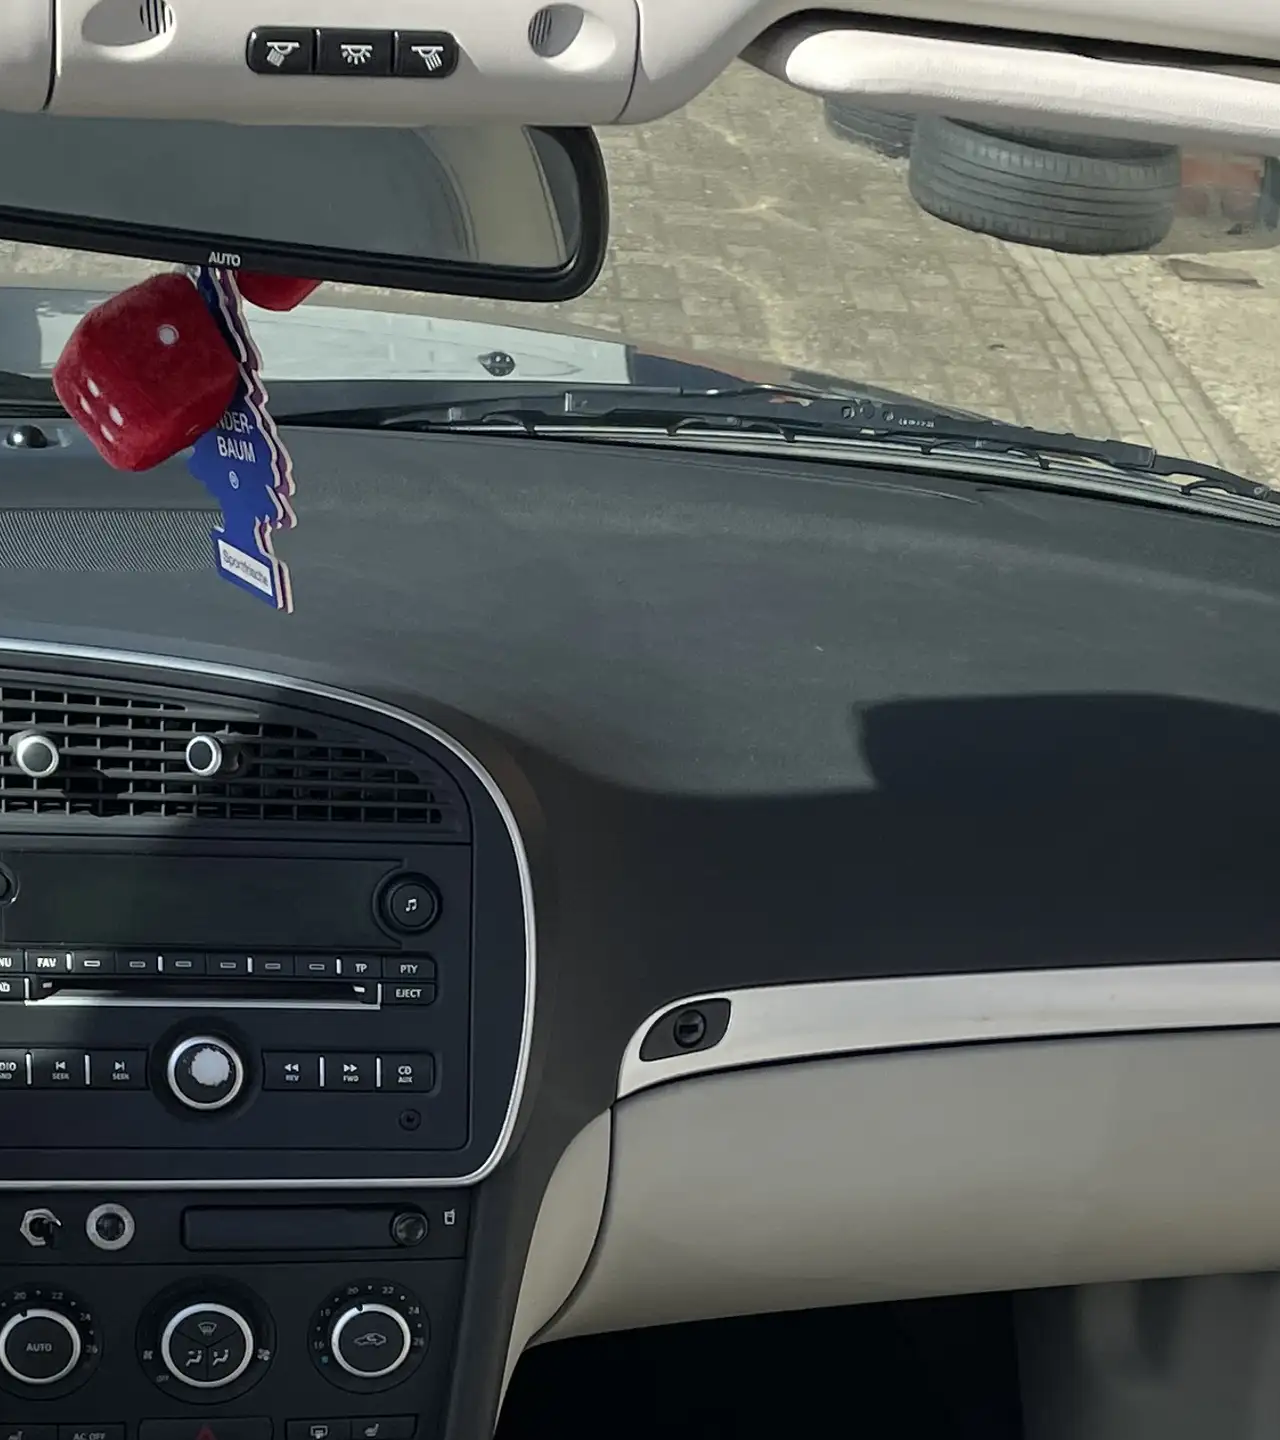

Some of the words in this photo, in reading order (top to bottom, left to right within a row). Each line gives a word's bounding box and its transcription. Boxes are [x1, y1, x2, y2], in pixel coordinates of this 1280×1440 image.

[208, 251, 241, 267] AUTO
[216, 436, 256, 463] BAUM
[36, 957, 57, 968] FAV
[355, 963, 368, 973] TP
[399, 964, 418, 974] PTY
[395, 988, 422, 998] EJECT
[397, 1065, 413, 1075] CD
[381, 1286, 395, 1295] 22
[25, 1342, 53, 1352] AUTO
